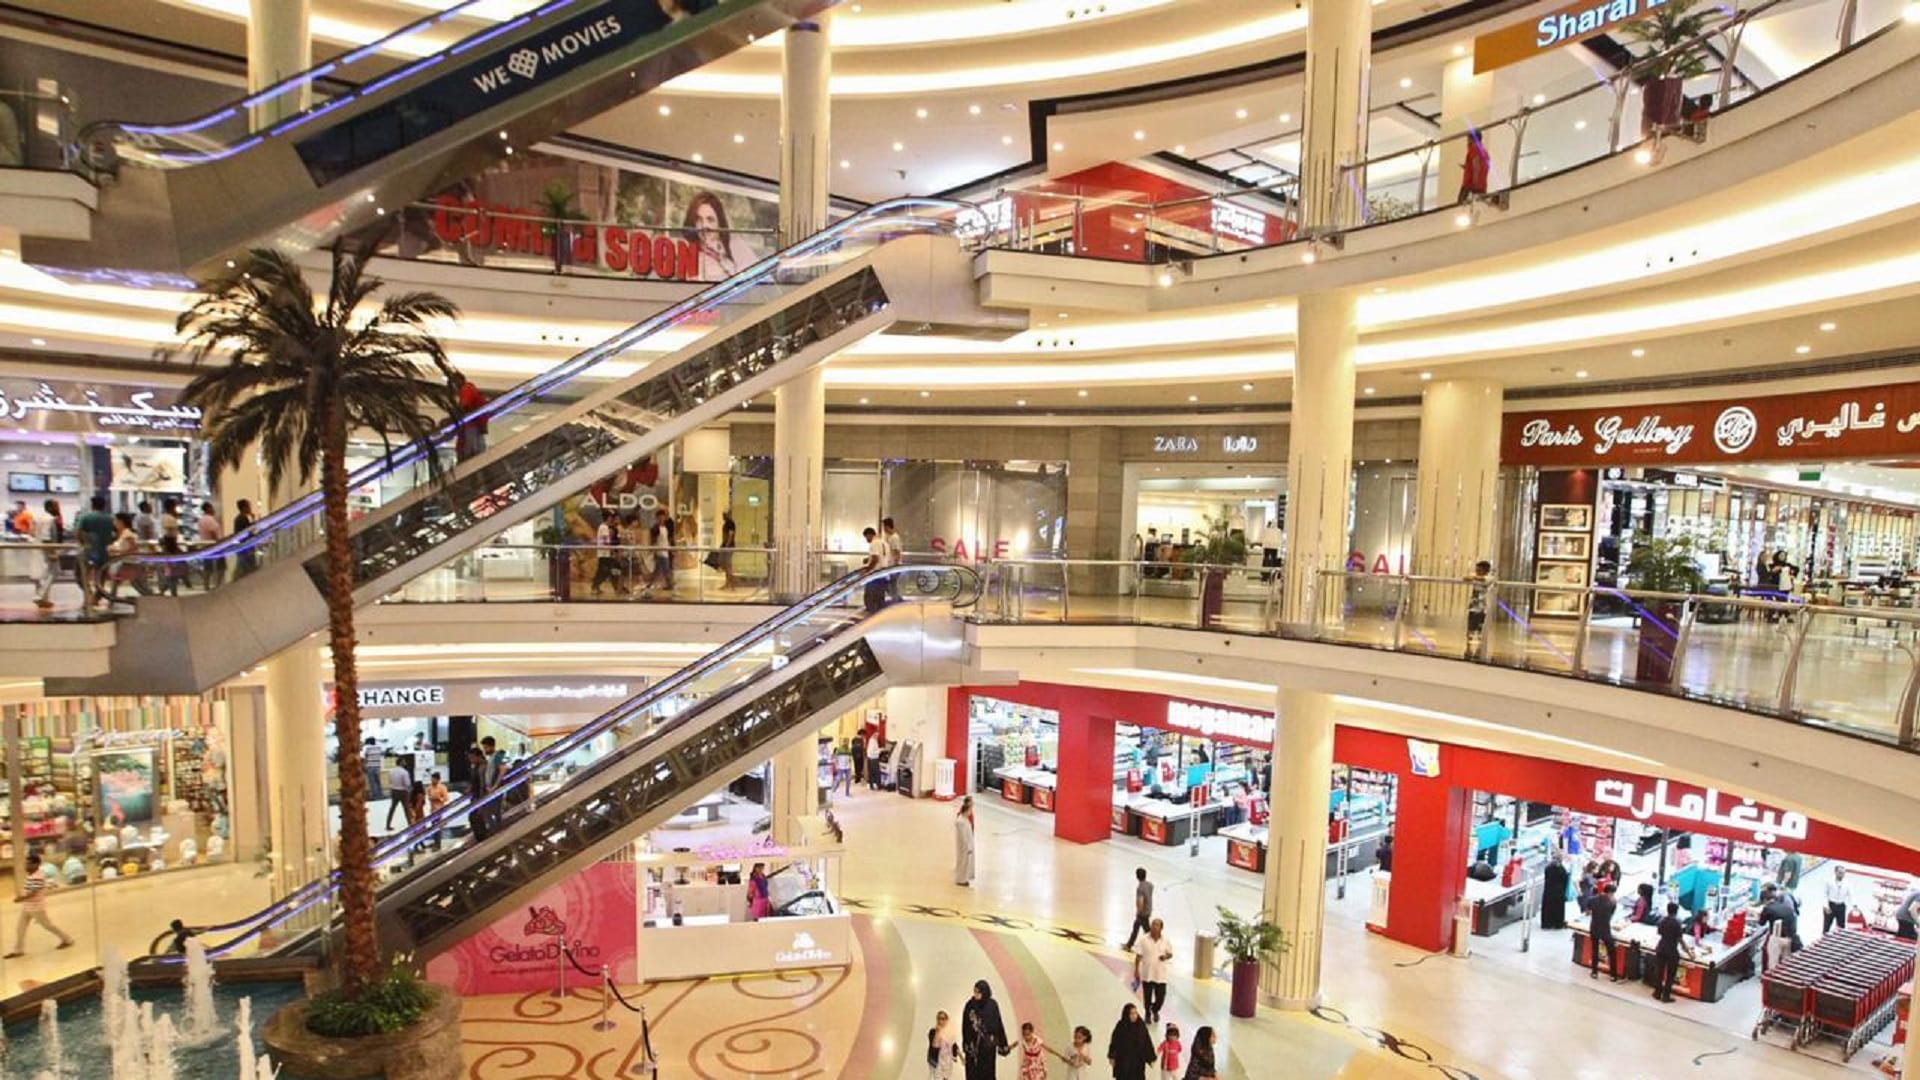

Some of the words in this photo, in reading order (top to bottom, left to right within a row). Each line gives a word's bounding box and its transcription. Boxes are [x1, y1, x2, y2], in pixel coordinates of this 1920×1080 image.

[473, 65, 512, 93] WE
[541, 15, 622, 65] MOVIES
[604, 226, 700, 280] SOON
[1520, 419, 1583, 447] Paris
[1594, 415, 1695, 454] Gallery
[1777, 402, 1887, 446] غاليري
[1153, 435, 1199, 453] ZARA
[580, 492, 658, 510] ALDO
[930, 537, 1009, 561] SALE
[1346, 549, 1406, 577] SAL
[347, 687, 442, 705] HANGE
[1167, 700, 1276, 743] megamar
[1594, 777, 1809, 844] ميغامارت
